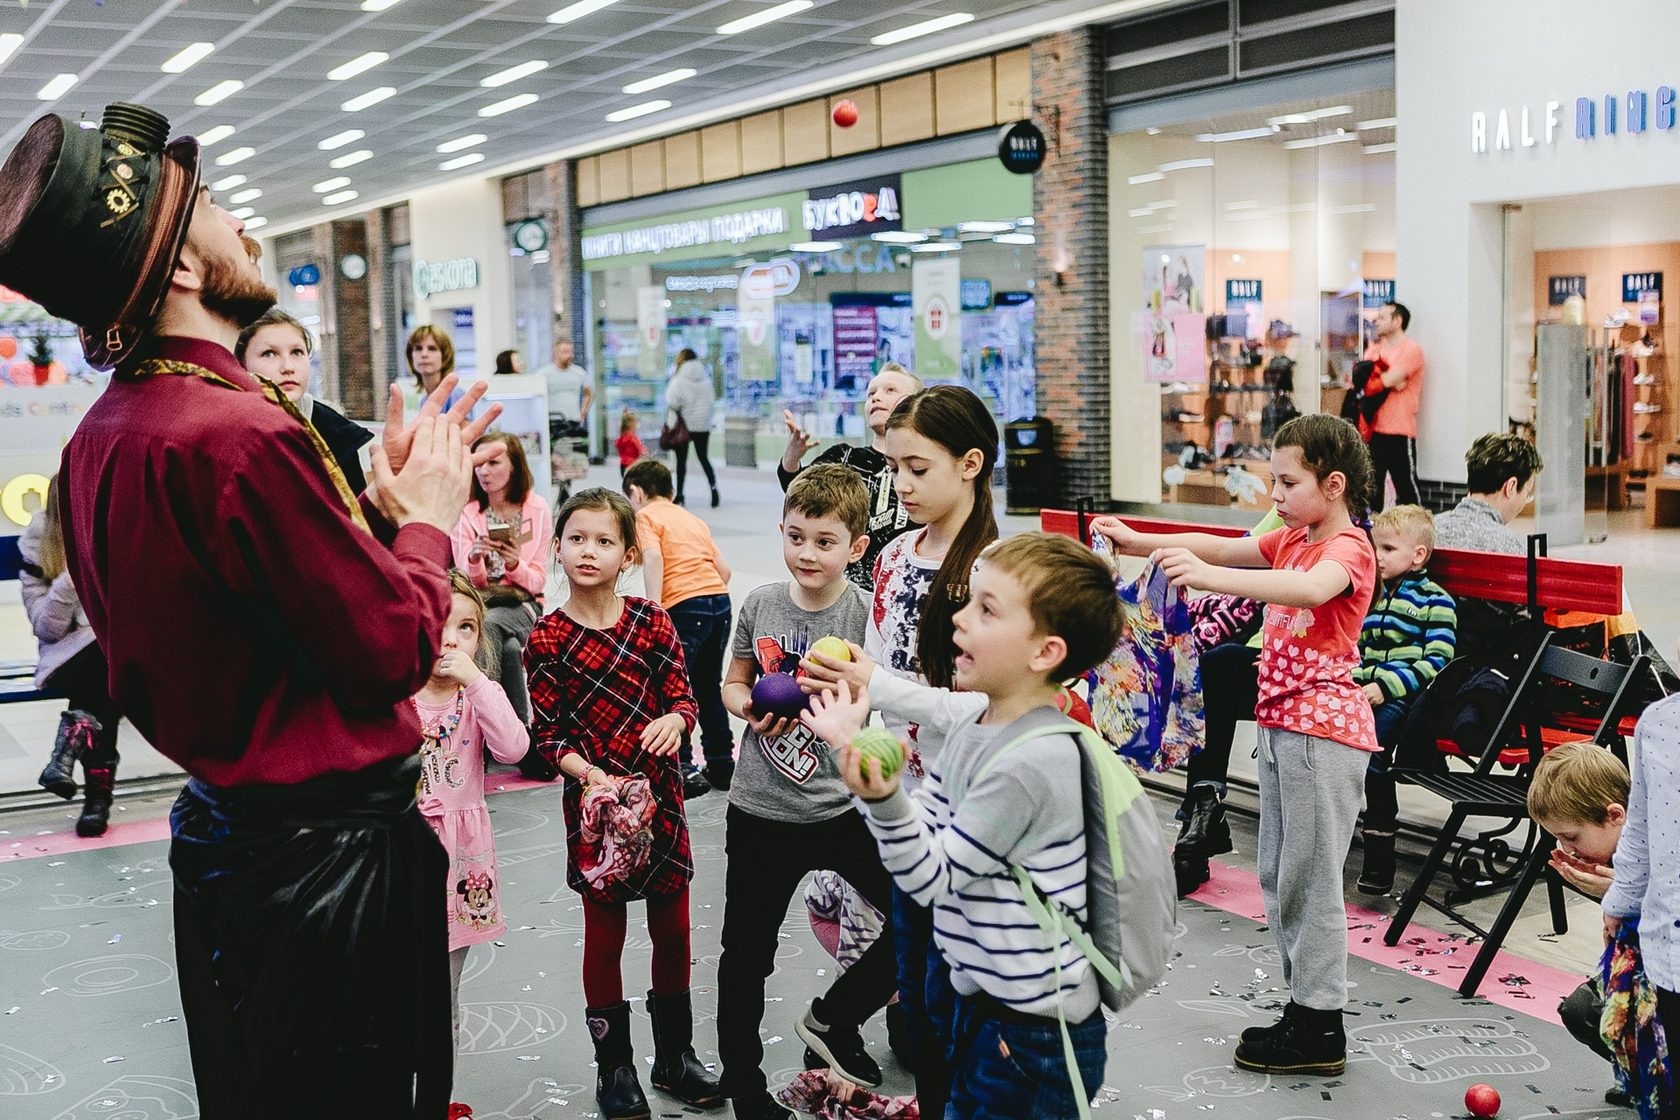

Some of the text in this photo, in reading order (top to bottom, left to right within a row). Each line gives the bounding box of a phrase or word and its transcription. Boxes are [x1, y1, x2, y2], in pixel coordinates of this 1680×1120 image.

[1471, 86, 1676, 154] RALF RING
[582, 207, 784, 260] КНИГИ КАНЦТОВАРЫ ПОДАРКИ
[771, 737, 815, 776] ON!
